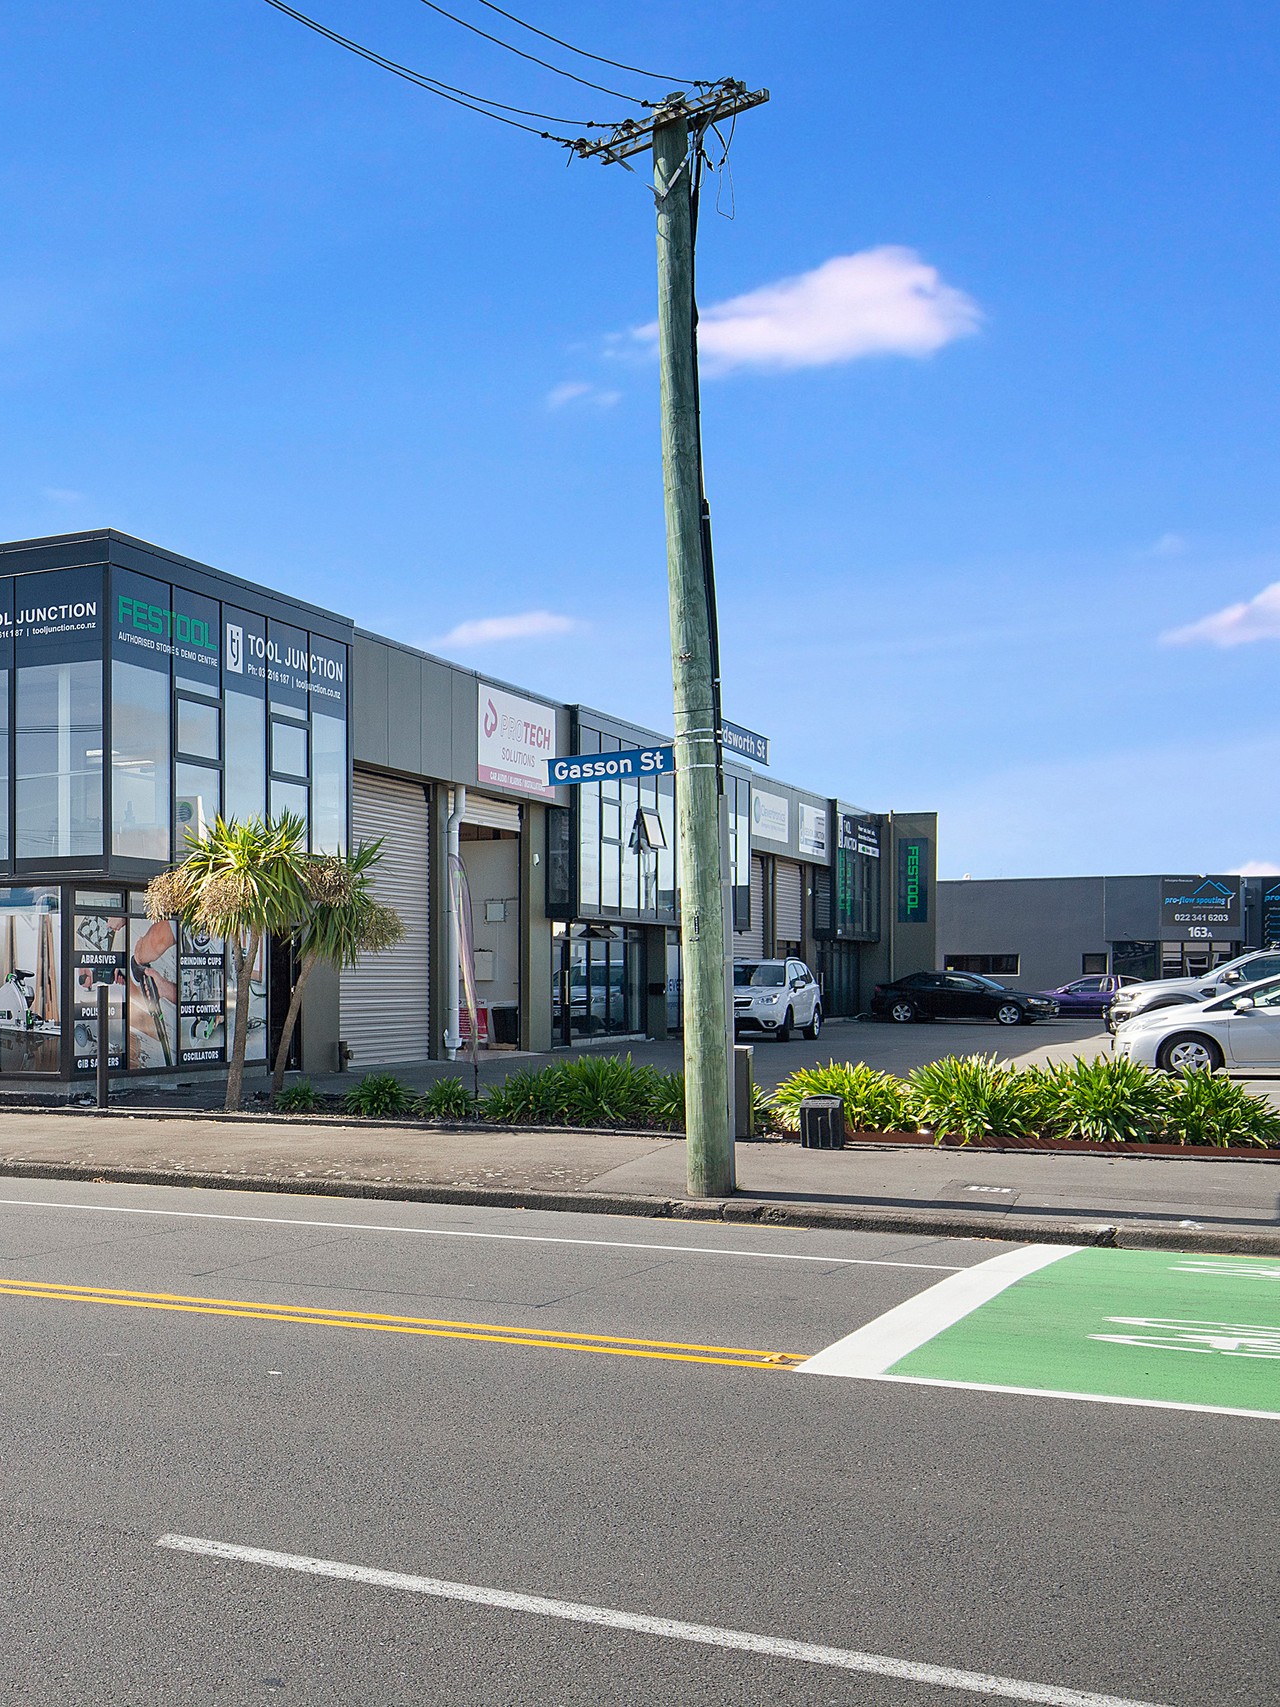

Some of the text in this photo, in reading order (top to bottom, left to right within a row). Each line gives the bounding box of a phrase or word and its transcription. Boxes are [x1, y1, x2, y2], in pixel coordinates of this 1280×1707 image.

[16, 601, 97, 625] JUNCTION
[118, 595, 217, 651] FESTOOL
[32, 621, 97, 635] tooljunction.co.nz
[118, 631, 155, 649] AUTHORISED
[156, 641, 175, 655] STORE
[180, 648, 196, 660] DEMO
[197, 653, 218, 667] CENTRE
[247, 634, 343, 682] TOOL JUNCTION
[247, 663, 258, 676] Ph:
[258, 666, 266, 678] 03
[279, 674, 290, 685] 187
[296, 678, 341, 700] tooljunction.co.nz
[500, 714, 551, 751] PROTECH
[722, 726, 766, 759] dsworth St
[501, 747, 535, 768] SOLUTIONS
[554, 751, 664, 780] Gasson St
[907, 846, 919, 915] FESTOOL
[1164, 896, 1226, 905] pro-flow spouting
[1174, 914, 1229, 922] 022 341 6203
[1187, 926, 1213, 938] 163A
[80, 954, 117, 964] ABRASIVES
[180, 956, 222, 966] GRINDING CUPS
[180, 1004, 221, 1014] DUST CONTROL
[77, 1056, 120, 1069] GIB SAERS
[183, 1051, 219, 1061] OSCILLATORS
